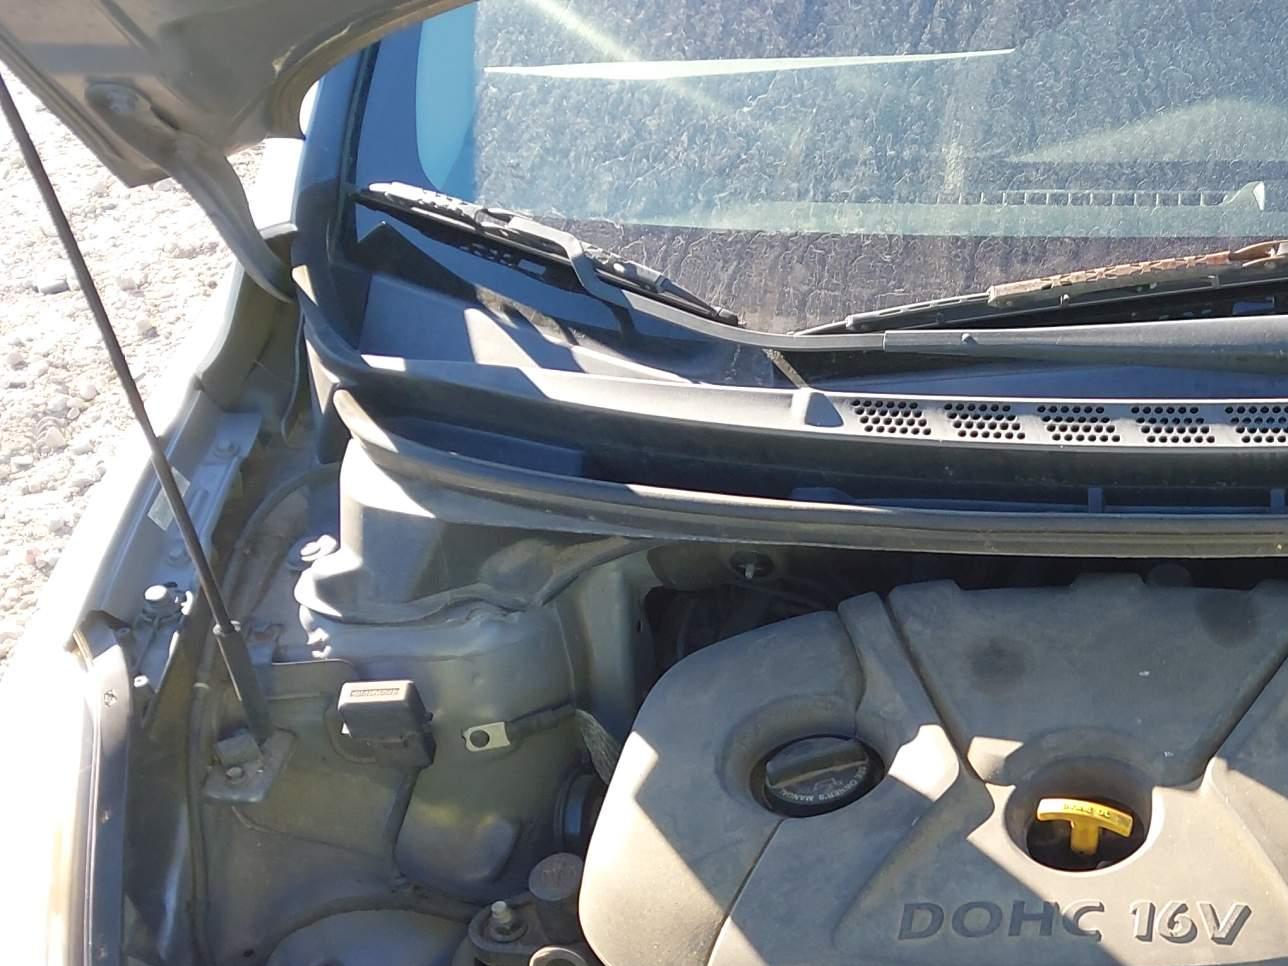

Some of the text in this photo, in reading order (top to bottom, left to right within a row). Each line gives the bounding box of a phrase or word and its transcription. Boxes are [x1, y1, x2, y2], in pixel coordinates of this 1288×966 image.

[780, 787, 815, 802] MANUAL
[818, 779, 858, 801] OWNER'S
[897, 899, 1252, 946] DOHC 16V
